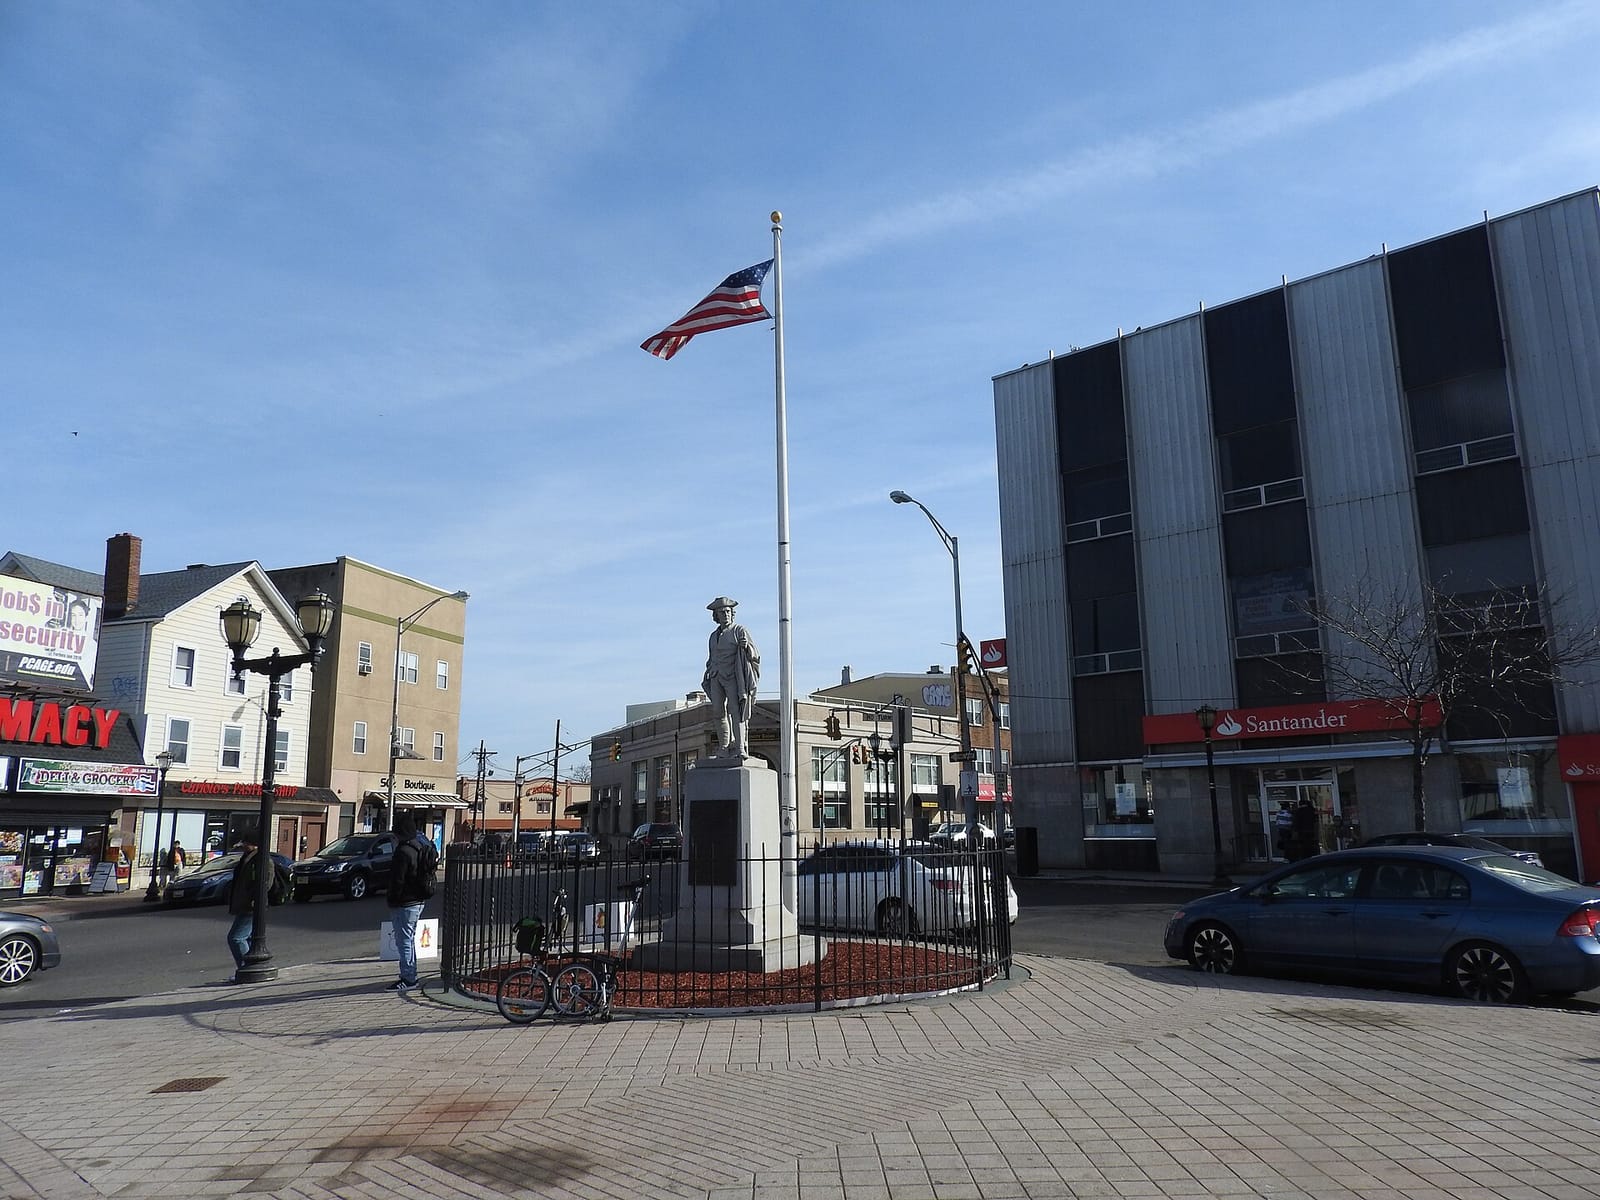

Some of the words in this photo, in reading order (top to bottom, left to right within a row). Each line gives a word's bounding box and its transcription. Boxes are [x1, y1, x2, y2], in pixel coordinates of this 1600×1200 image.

[45, 596, 64, 619] in
[0, 620, 86, 654] security
[0, 697, 120, 748] MACY
[1246, 709, 1348, 733] Santander
[39, 771, 70, 784] DELI
[71, 772, 81, 784] &
[83, 773, 138, 786] GROCERY
[233, 782, 263, 795] PASTR
